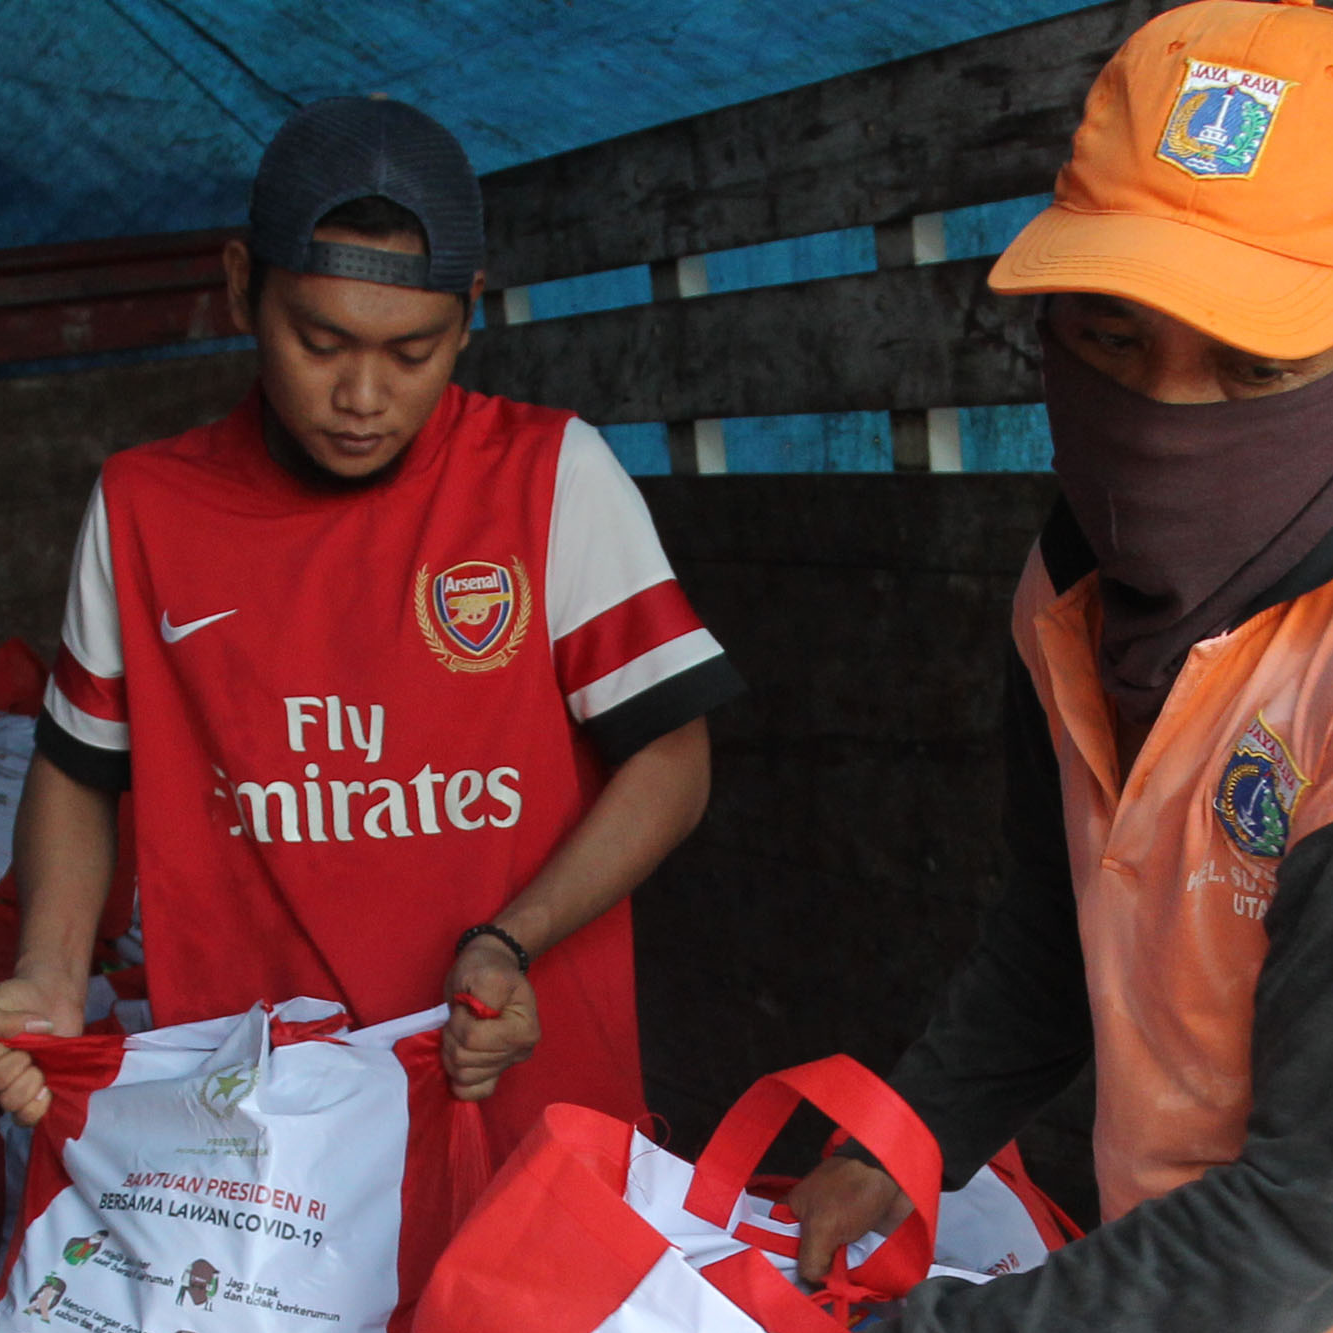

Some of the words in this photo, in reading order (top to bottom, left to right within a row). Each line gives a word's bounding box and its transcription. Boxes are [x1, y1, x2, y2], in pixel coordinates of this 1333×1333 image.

[1191, 65, 1229, 83] JAYA
[1240, 74, 1281, 97] RAYA
[444, 571, 499, 593] Arsenal
[283, 694, 385, 764] Fly
[1247, 722, 1276, 755] JAYA
[212, 762, 522, 843] mirates
[123, 1172, 203, 1194] BANTUAN
[205, 1178, 303, 1215] PRESIDEN
[307, 1199, 327, 1221] RI
[99, 1193, 163, 1216] BERSAMA
[168, 1200, 230, 1229] LAWAN
[233, 1211, 324, 1249] COVID-19
[225, 1277, 251, 1293] Jaga
[252, 1282, 281, 1299] jarak
[223, 1289, 244, 1303] dan
[245, 1294, 274, 1310] tidak
[275, 1300, 341, 1322] berkerumun
